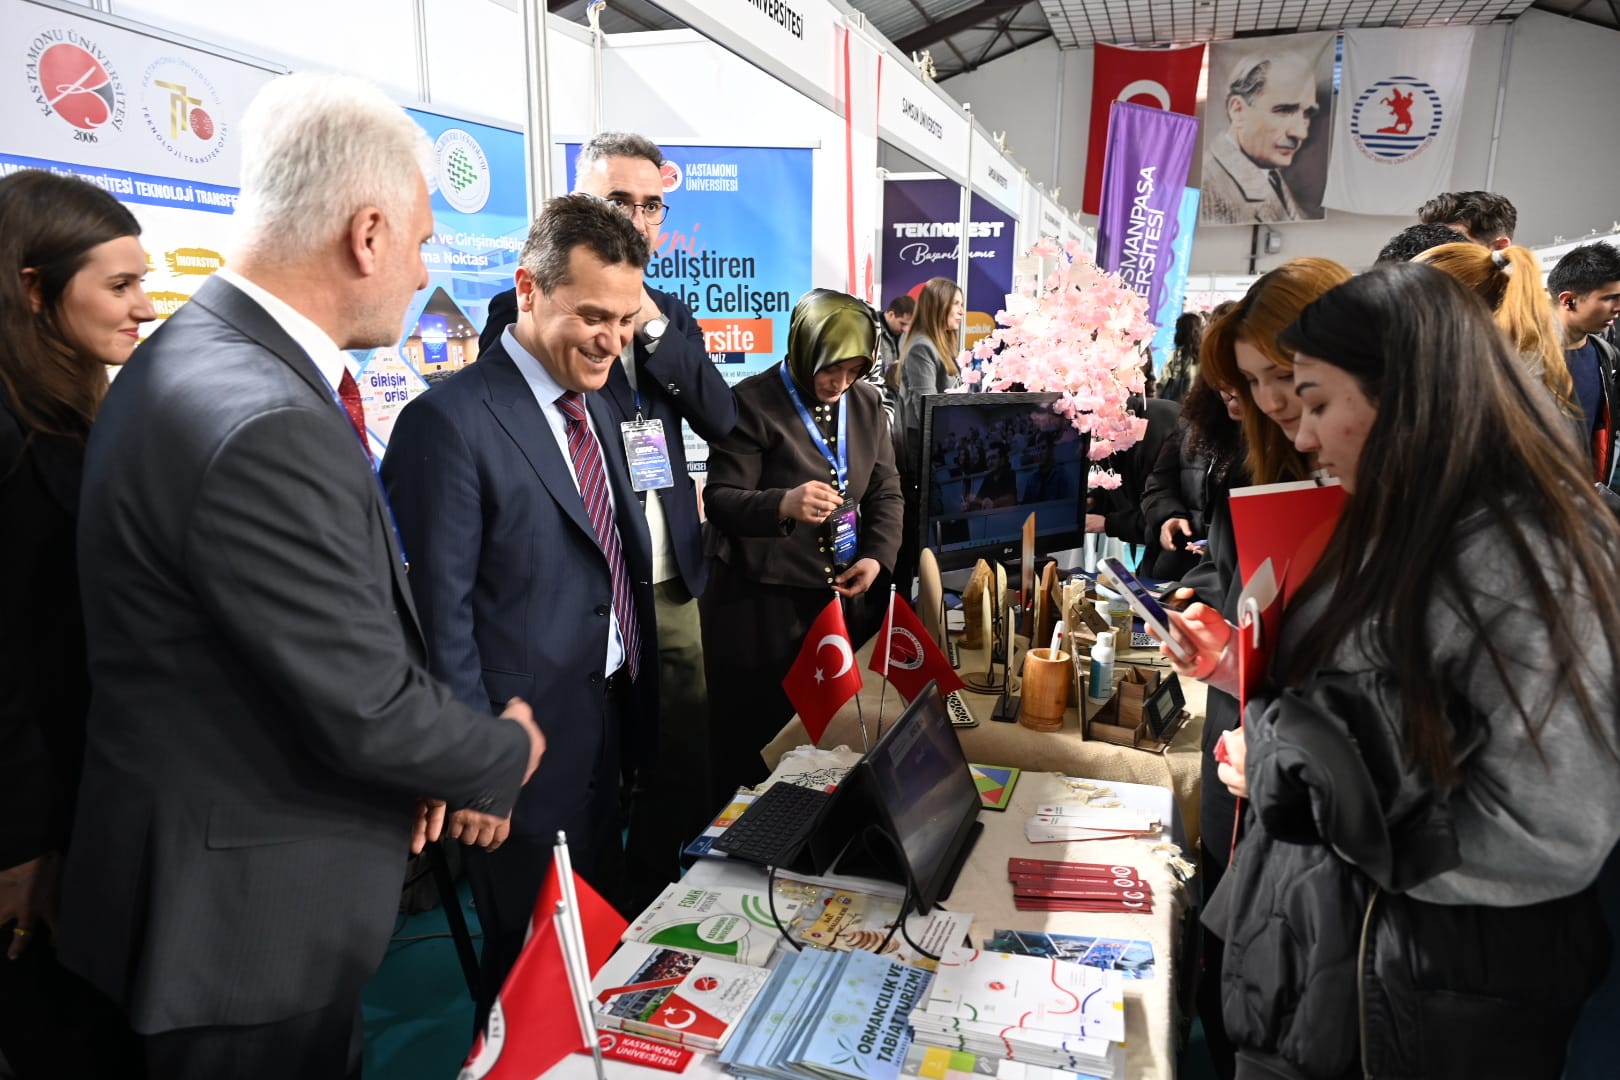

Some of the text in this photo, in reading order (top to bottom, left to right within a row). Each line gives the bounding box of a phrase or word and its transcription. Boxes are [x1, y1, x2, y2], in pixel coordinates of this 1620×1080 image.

[26, 29, 126, 133] KASTAMONU ÜNİVERSİTESİ
[73, 129, 99, 144] 2006
[685, 163, 738, 178] KASTAMONU
[135, 181, 194, 202] TEKNOLOJİ
[685, 176, 739, 192] ÜNİVERSİTESİ
[654, 223, 706, 258] eni
[893, 222, 1005, 238] TEKNOEST
[444, 251, 489, 267] Noktası
[644, 249, 756, 287] Geliştiren
[706, 282, 790, 320] Gelişen
[703, 324, 755, 352] rsite
[370, 372, 407, 389] GİRİŞİM
[384, 388, 409, 402] OFİSİ
[857, 962, 904, 1055] ORMANCILIK VE
[876, 1014, 906, 1063] TABİAT
[894, 967, 923, 1017] TURİZMİ
[615, 1046, 678, 1067] ÜNİVERSİTESİ
[621, 1037, 682, 1059] KASTAMONU
